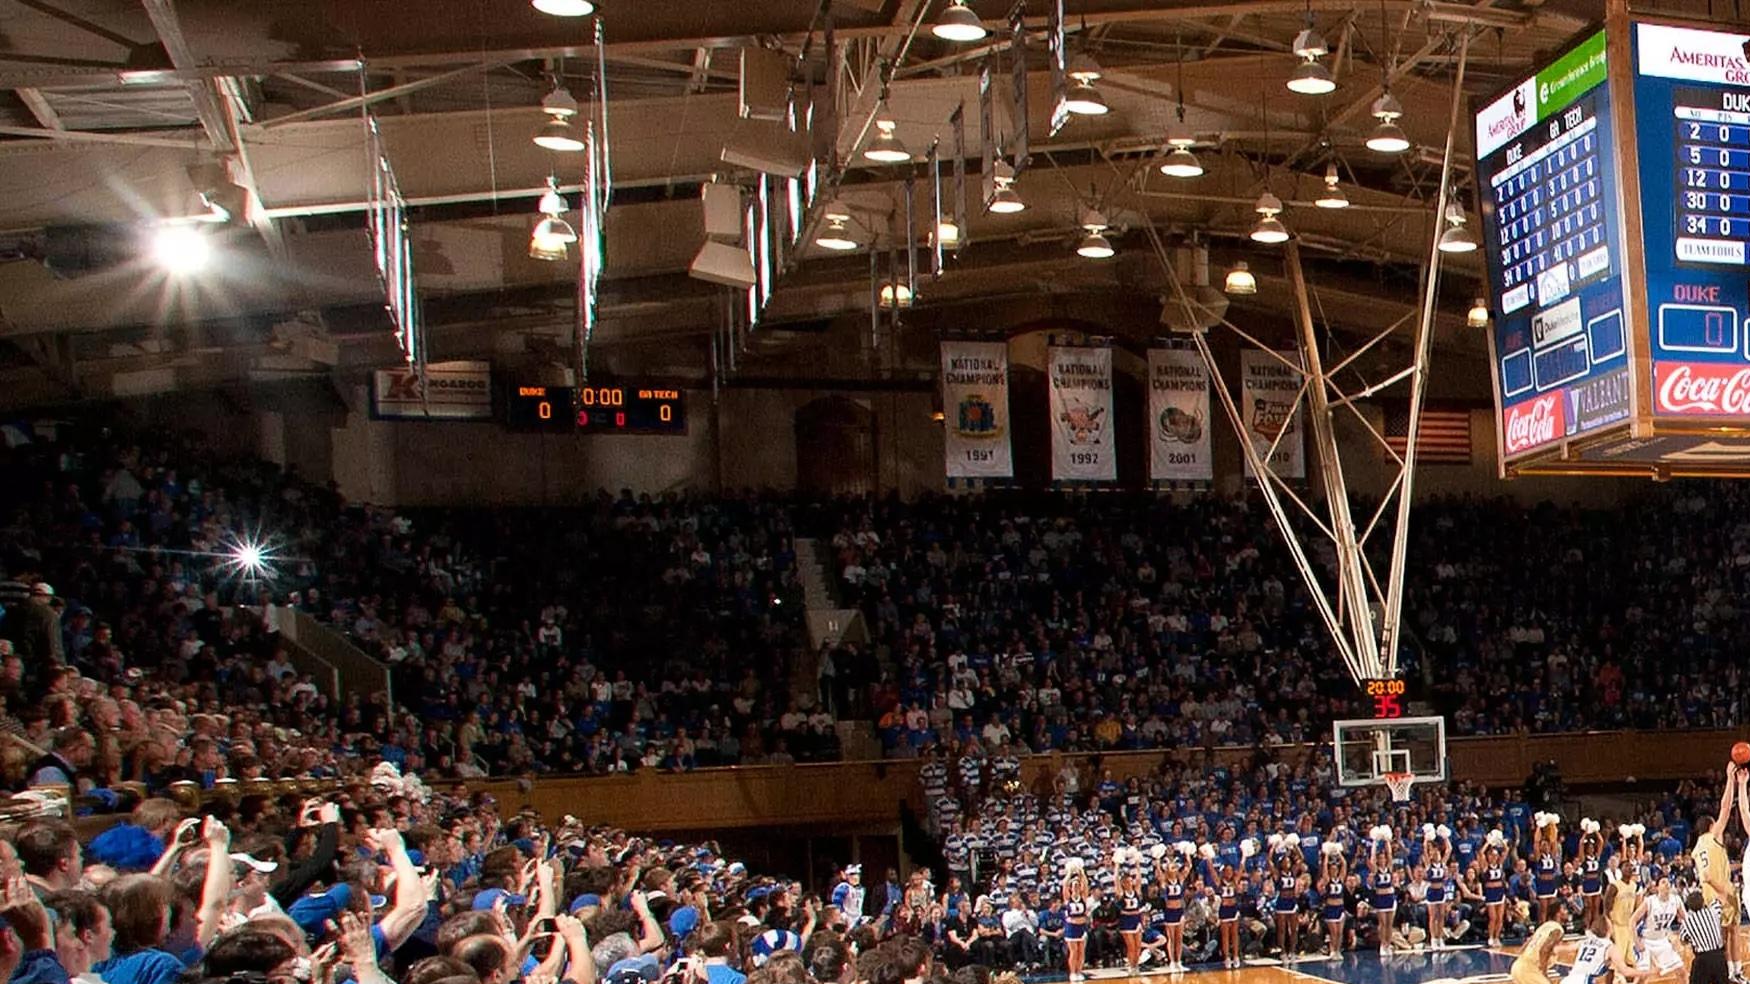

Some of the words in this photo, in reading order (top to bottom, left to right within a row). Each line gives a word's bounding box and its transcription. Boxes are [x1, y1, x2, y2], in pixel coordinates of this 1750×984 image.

[1670, 47, 1745, 70] AMERITAS
[1690, 122, 1700, 139] 2
[1720, 126, 1729, 142] 0
[1690, 146, 1701, 164] 5
[1720, 149, 1729, 167] 0
[1688, 169, 1706, 187] 12
[1720, 172, 1730, 189] 0
[1687, 192, 1706, 209] 30
[1720, 194, 1730, 211] 0
[1687, 216, 1706, 234] 34
[1720, 218, 1730, 235] 0
[1674, 285, 1719, 302] DUKE
[1705, 312, 1723, 346] 0
[951, 358, 999, 370] NATIONAL
[1058, 364, 1105, 375] NATIONAL
[1157, 365, 1200, 378] NATIONAL
[946, 373, 1005, 386] CHAMPIONS
[1053, 378, 1110, 391] CHAMPIONS
[1153, 379, 1206, 391] CHAMPIONS
[519, 387, 545, 397] DUKE
[539, 402, 551, 420] 0
[660, 404, 672, 421] 0
[966, 450, 994, 462] 1991
[1070, 453, 1098, 465] 1992
[1169, 453, 1197, 464] 2001
[1367, 680, 1405, 695] 20:00
[1374, 694, 1401, 718] 35
[1578, 945, 1597, 963] 12
